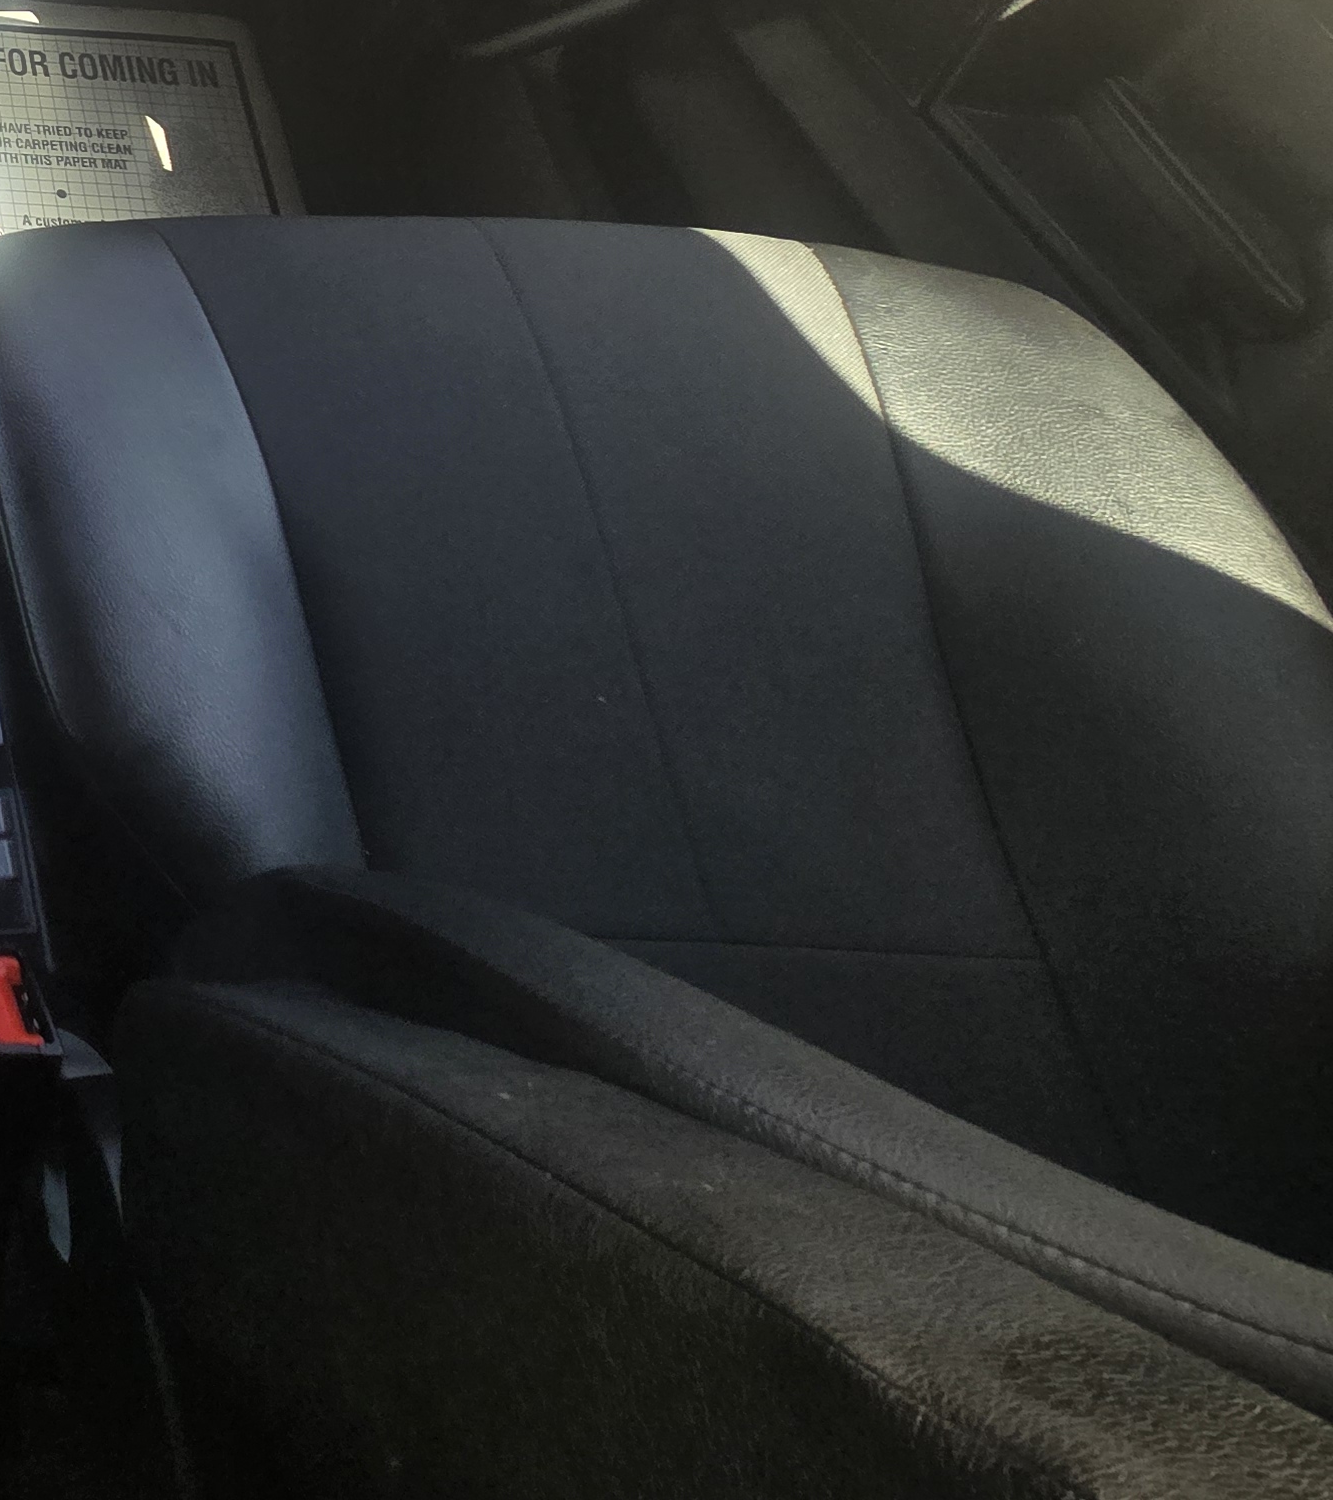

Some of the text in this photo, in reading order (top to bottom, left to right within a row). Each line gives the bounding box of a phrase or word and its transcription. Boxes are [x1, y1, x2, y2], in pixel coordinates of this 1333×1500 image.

[58, 51, 181, 87] COMING
[187, 59, 219, 88] IN
[0, 122, 32, 135] HAVE
[34, 124, 72, 137] TRIED
[75, 126, 93, 138] TO
[96, 128, 128, 140] KEEP
[15, 138, 88, 153] CARPETING
[91, 142, 132, 156] CLEAN
[24, 153, 52, 166] THIS
[56, 156, 98, 169] PAPER
[101, 158, 128, 170] MAT
[22, 214, 32, 226] A
